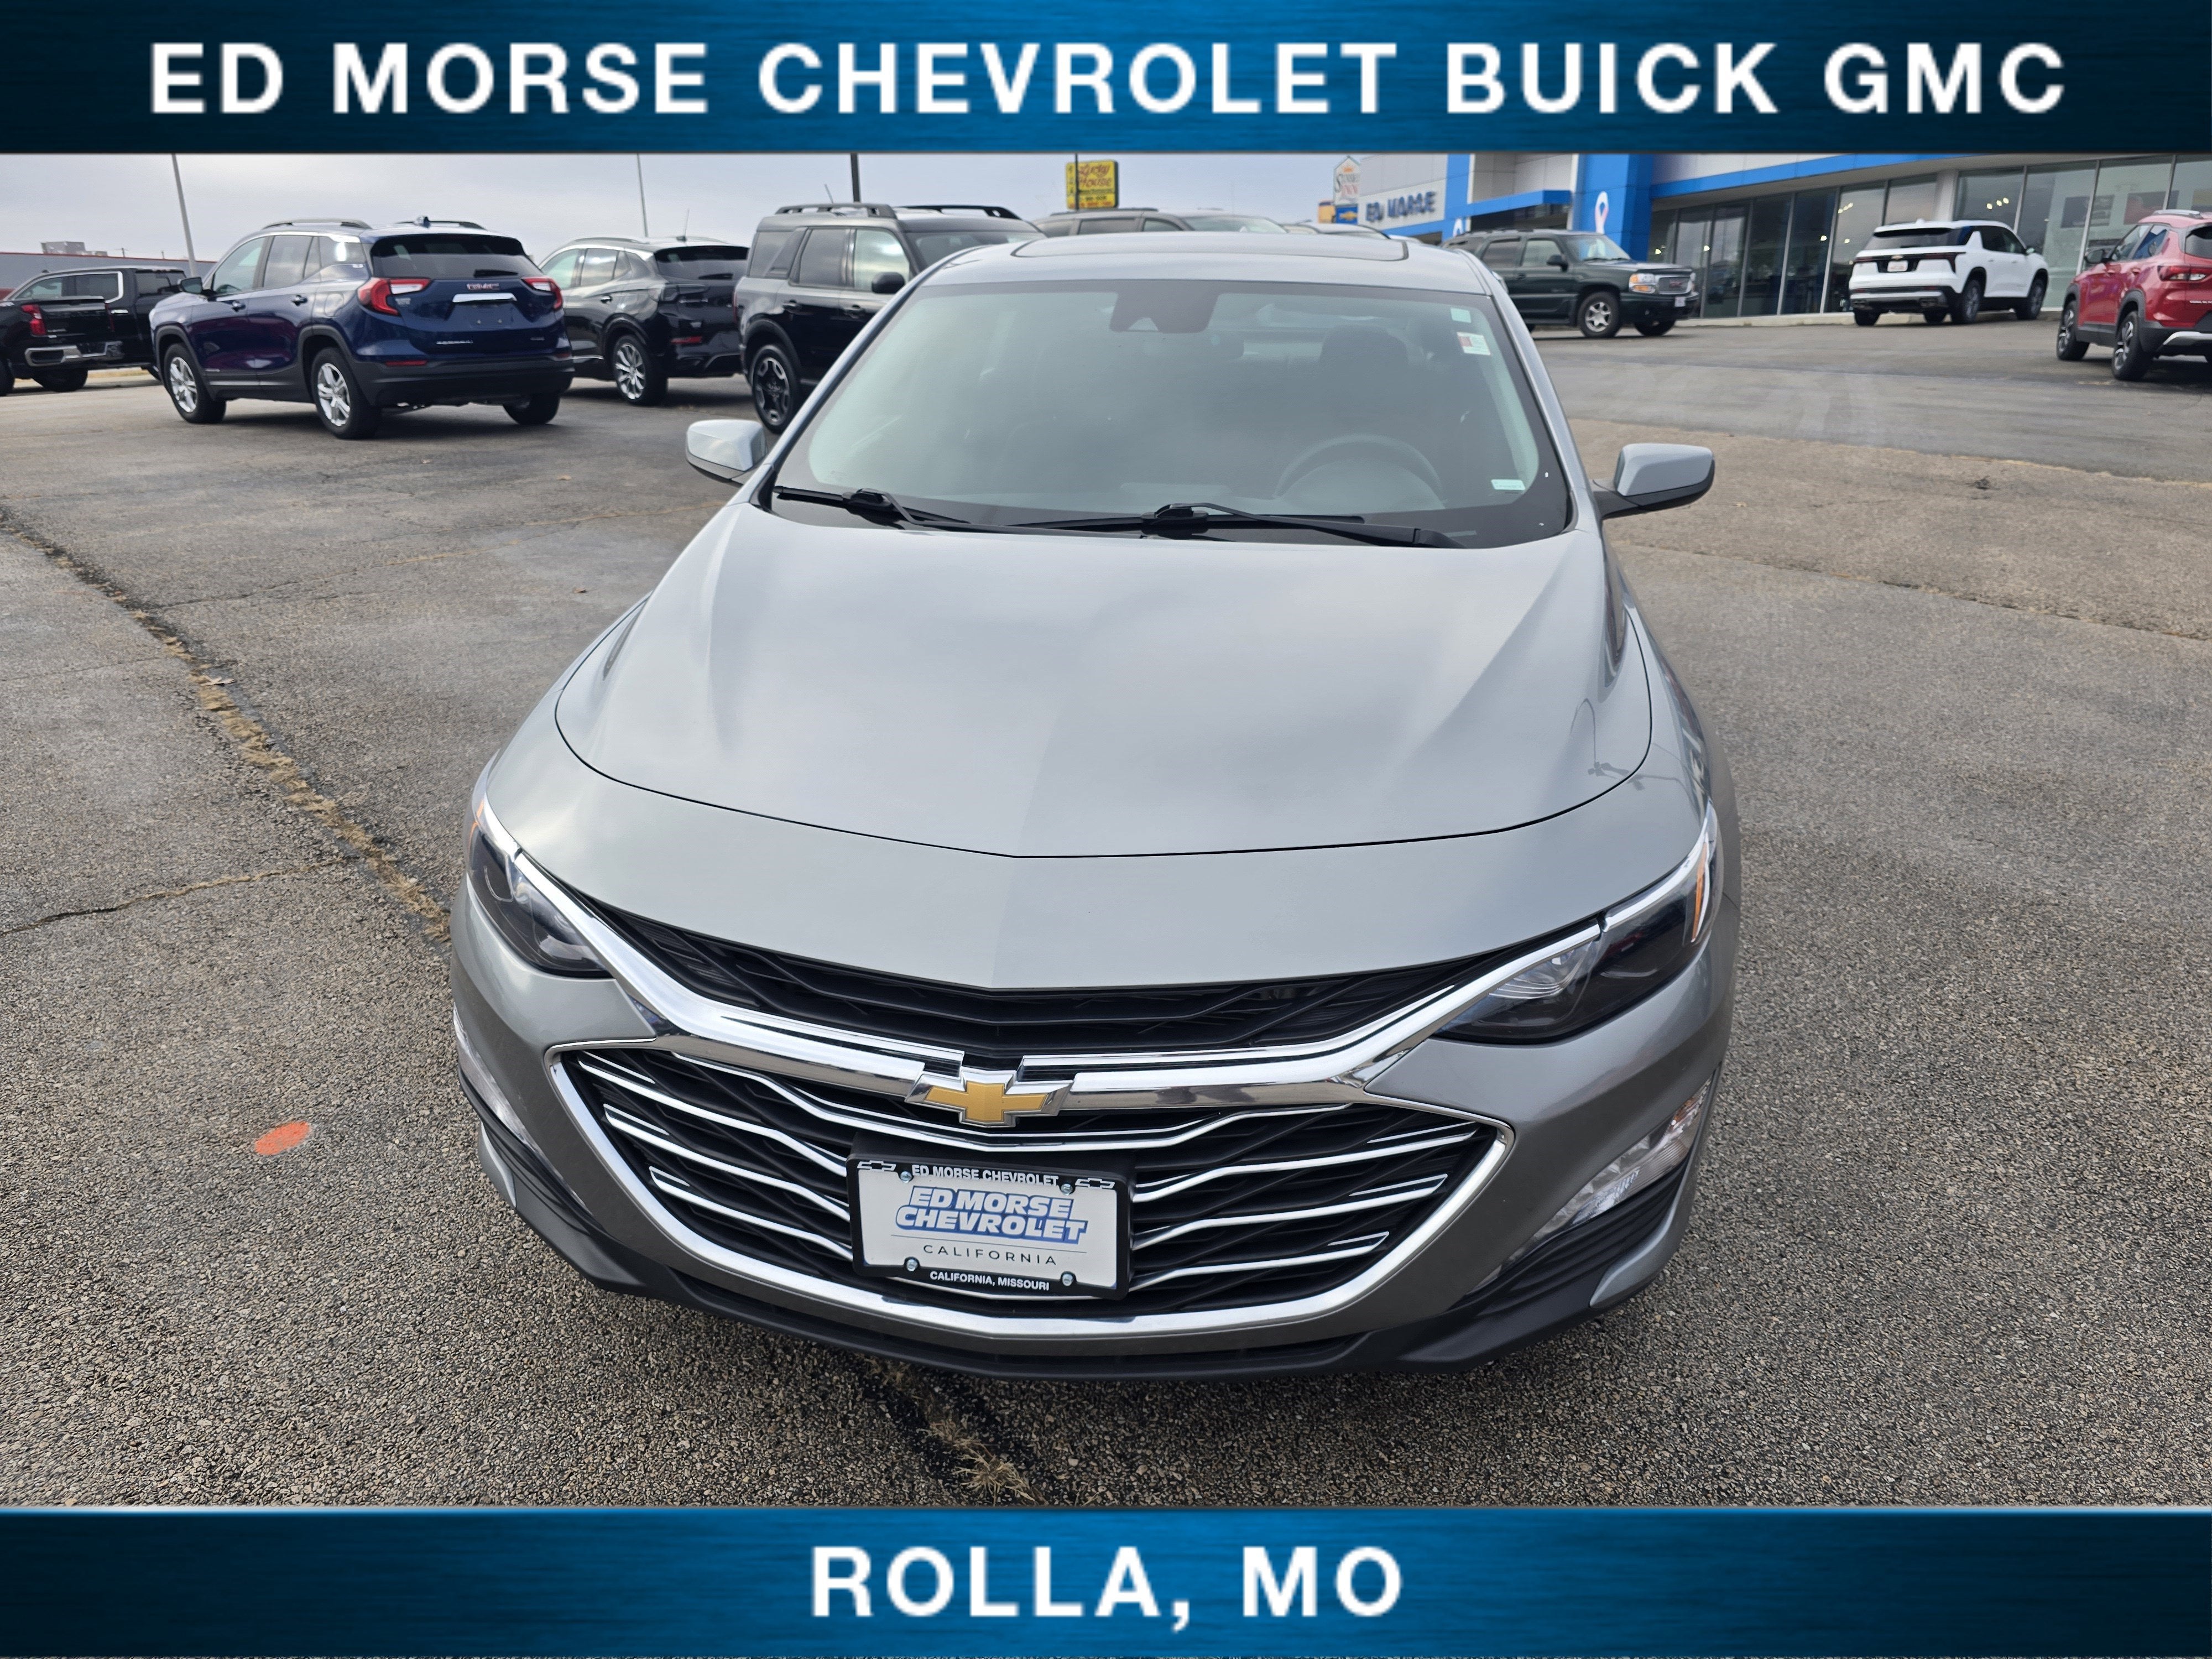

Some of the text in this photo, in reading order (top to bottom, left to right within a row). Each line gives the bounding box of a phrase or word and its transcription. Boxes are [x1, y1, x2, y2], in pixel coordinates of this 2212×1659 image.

[1366, 191, 1436, 222] ED MORSE
[912, 1164, 1059, 1186] ED MORSE CHEVROLET
[910, 1186, 1074, 1220] ED MORSE
[896, 1204, 1088, 1244] CHEVROLET
[923, 1244, 1057, 1265] CALIFORNIA
[930, 1271, 1050, 1291] CALIFORNIA, MISSOURI
